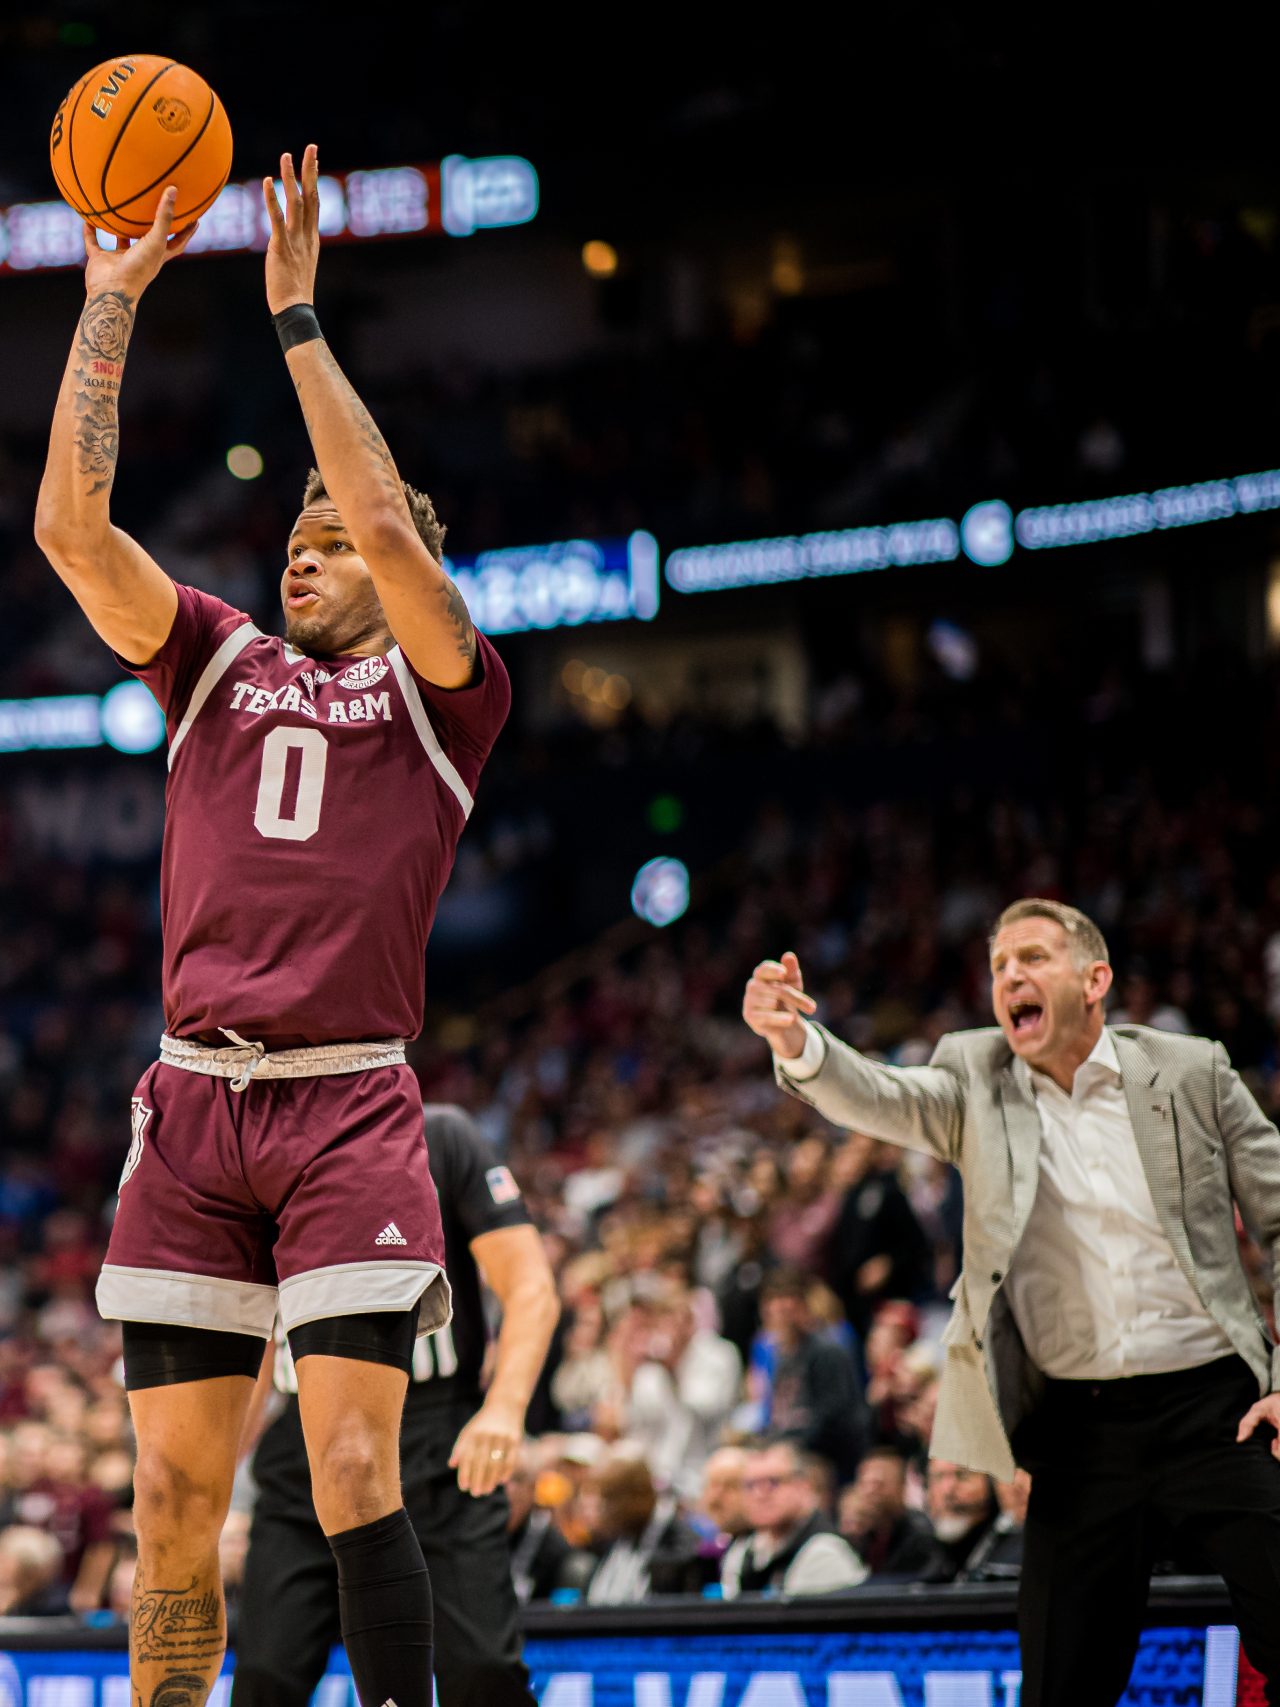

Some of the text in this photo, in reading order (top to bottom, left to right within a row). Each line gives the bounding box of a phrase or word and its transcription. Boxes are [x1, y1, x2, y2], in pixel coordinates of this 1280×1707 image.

[347, 657, 379, 680] SEC
[328, 691, 393, 723] A&M
[253, 725, 329, 842] 0
[374, 1236, 408, 1246] adidas
[134, 1577, 220, 1637] Family
